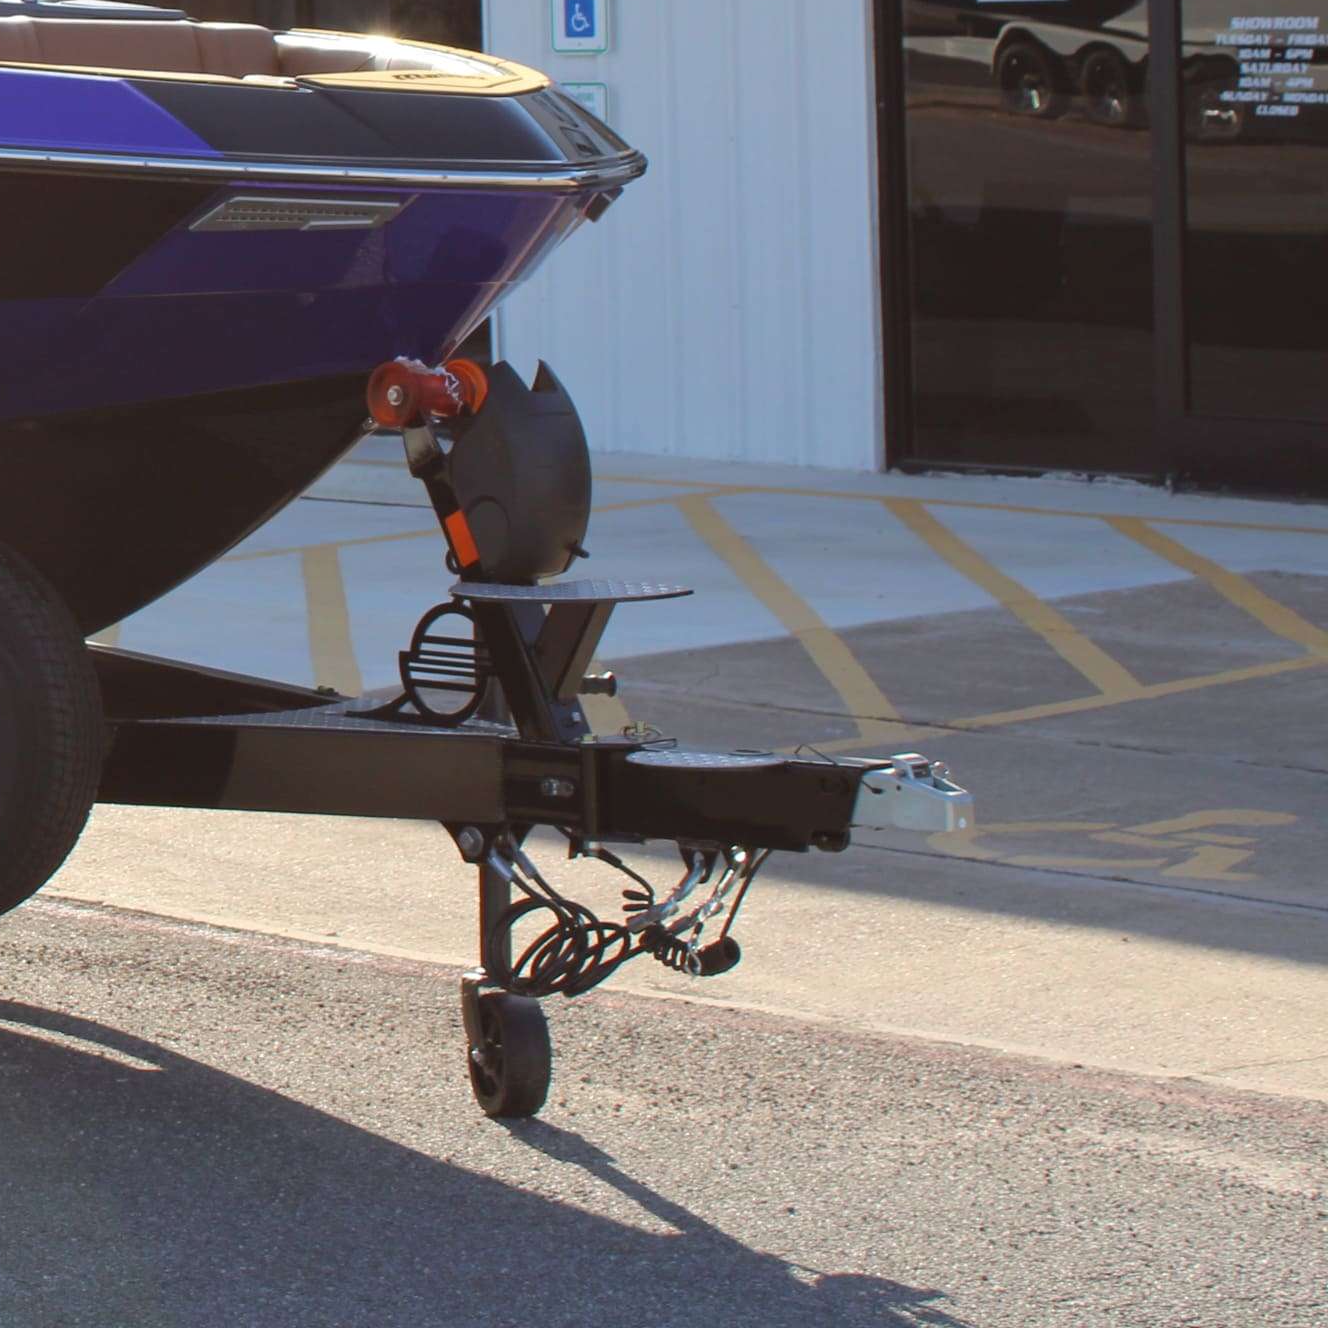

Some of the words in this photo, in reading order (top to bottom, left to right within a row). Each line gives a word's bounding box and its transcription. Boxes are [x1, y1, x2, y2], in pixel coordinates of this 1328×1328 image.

[1230, 16, 1319, 30] SHOWROOM
[1240, 62, 1309, 74] SATURDAY
[1255, 104, 1299, 117] CLOSED
